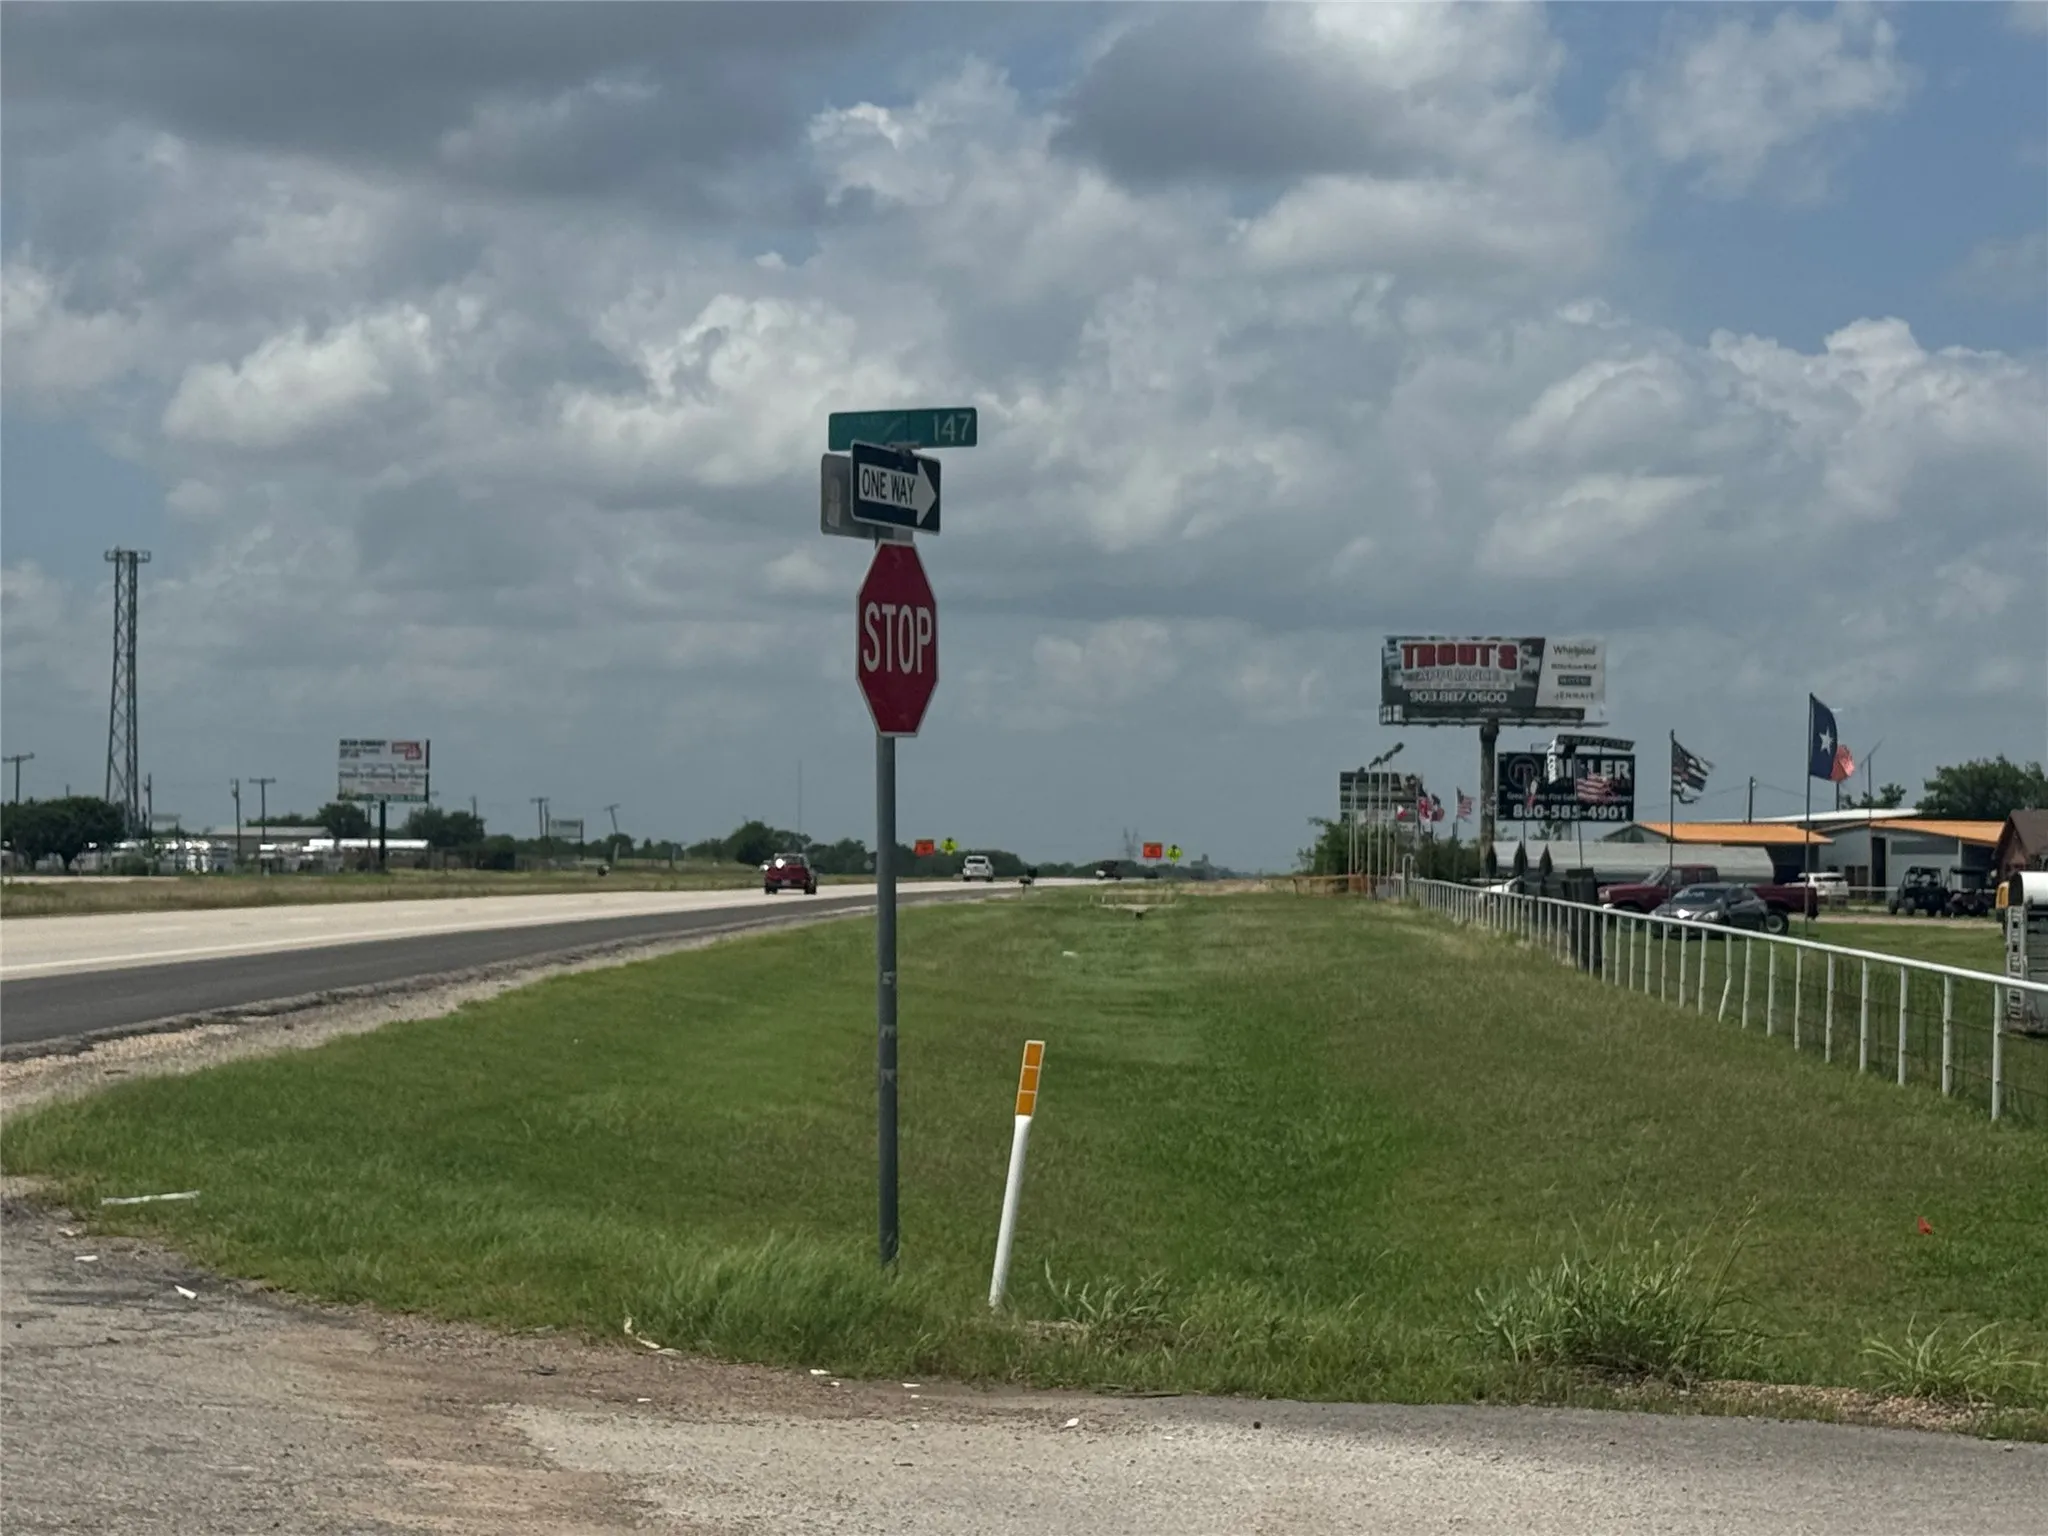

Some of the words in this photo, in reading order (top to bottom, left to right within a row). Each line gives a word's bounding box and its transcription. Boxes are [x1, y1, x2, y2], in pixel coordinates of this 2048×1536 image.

[933, 413, 972, 442] 147
[862, 468, 887, 500] ONE
[890, 474, 917, 506] WAY
[862, 602, 933, 675] STOP
